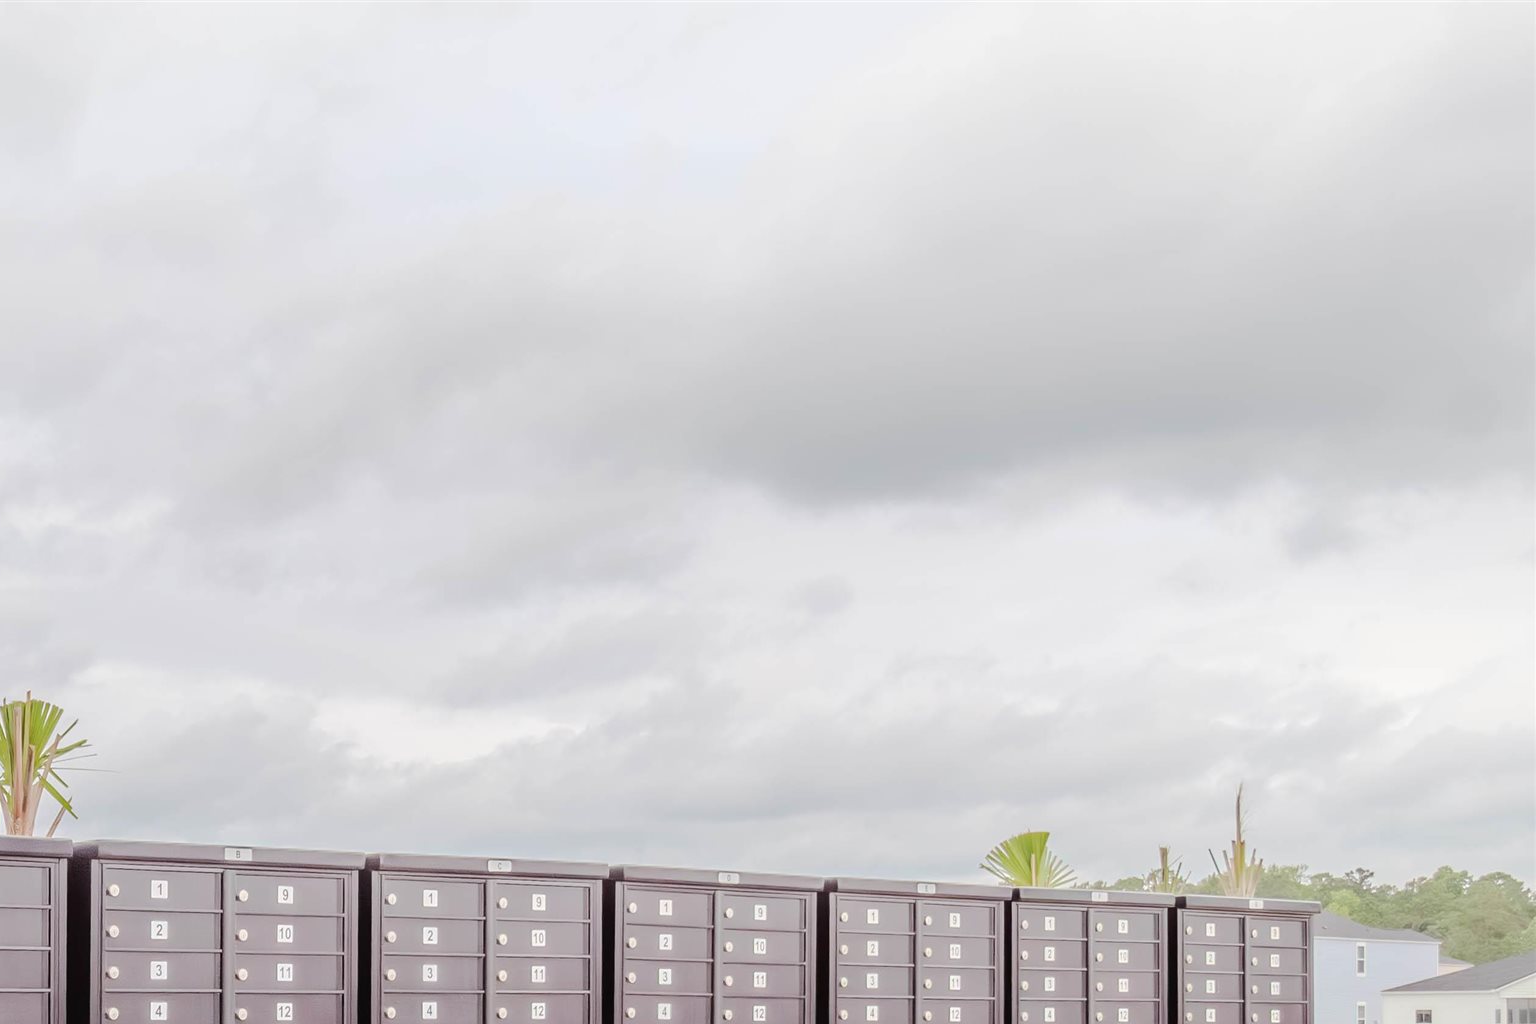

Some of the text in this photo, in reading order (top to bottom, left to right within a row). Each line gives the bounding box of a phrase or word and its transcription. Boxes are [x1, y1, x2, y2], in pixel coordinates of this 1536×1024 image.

[157, 883, 163, 896] 1
[282, 888, 289, 902] 9
[428, 892, 433, 905] 1
[535, 896, 542, 908] 9
[663, 901, 668, 913] 1
[757, 907, 764, 918] 9
[156, 923, 163, 937] 2
[279, 927, 292, 940] 10
[427, 929, 434, 942] 2
[533, 932, 544, 944] 10
[663, 936, 669, 948] 2
[755, 940, 765, 952] 10
[951, 946, 960, 957] 10
[155, 964, 163, 977] 3
[279, 966, 291, 979] 11
[427, 967, 434, 980] 3
[534, 968, 544, 980] 11
[662, 970, 668, 983] 3
[755, 974, 765, 985] 11
[951, 977, 959, 988] 11
[155, 1005, 163, 1017] 4
[278, 1005, 291, 1018] 12
[426, 1004, 433, 1017] 4
[533, 1005, 544, 1017] 12
[661, 1006, 668, 1017] 4
[755, 1008, 765, 1019] 12
[951, 1009, 960, 1020] 12
